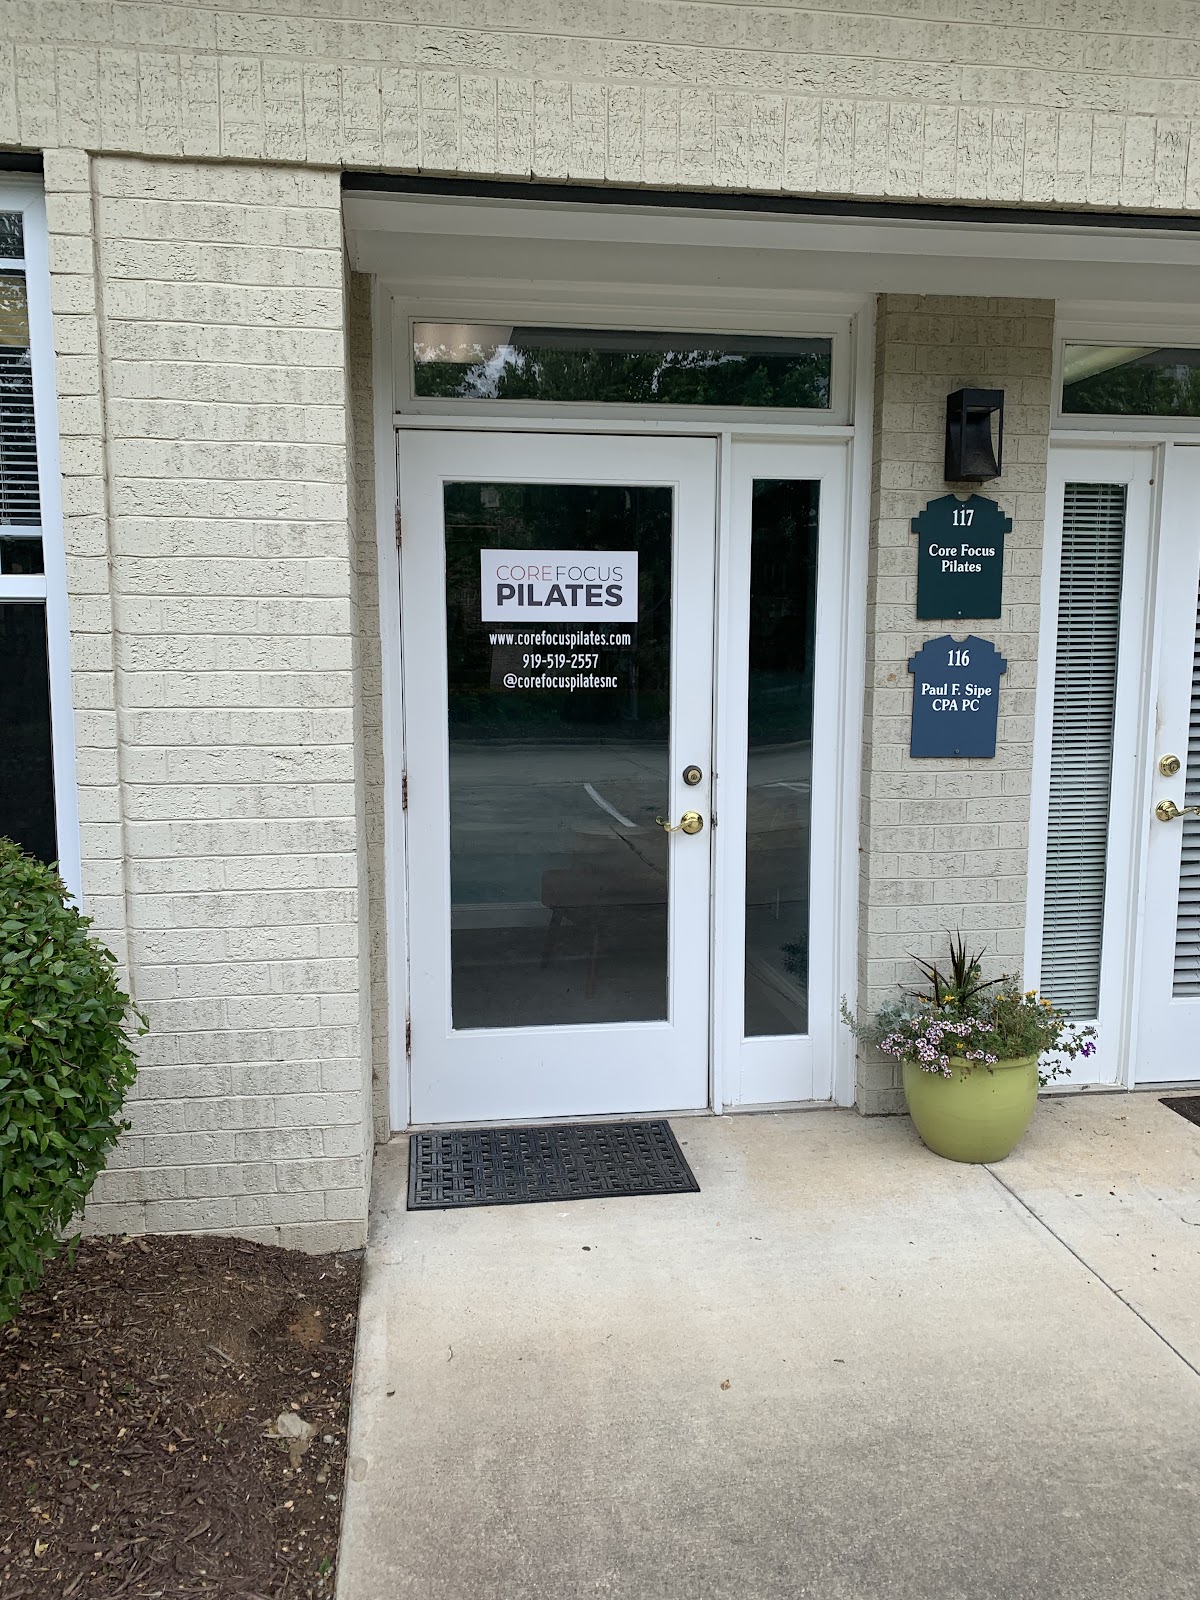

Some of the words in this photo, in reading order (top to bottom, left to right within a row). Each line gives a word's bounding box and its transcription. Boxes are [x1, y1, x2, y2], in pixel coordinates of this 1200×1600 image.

[952, 509, 975, 526] 117
[928, 543, 957, 556] Core
[961, 543, 996, 556] Focus
[941, 559, 982, 572] Pilates
[496, 583, 623, 607] PILATES
[489, 630, 631, 649] www.corefocuspilates.com
[522, 653, 599, 669] 919-519-2557
[947, 649, 970, 666] 116
[503, 672, 618, 692] @corefocuspilatesnc
[921, 683, 948, 696] Paul
[951, 683, 961, 696] F.
[965, 683, 992, 698] Sipe
[932, 699, 958, 711] CPA
[961, 699, 980, 711] PC
